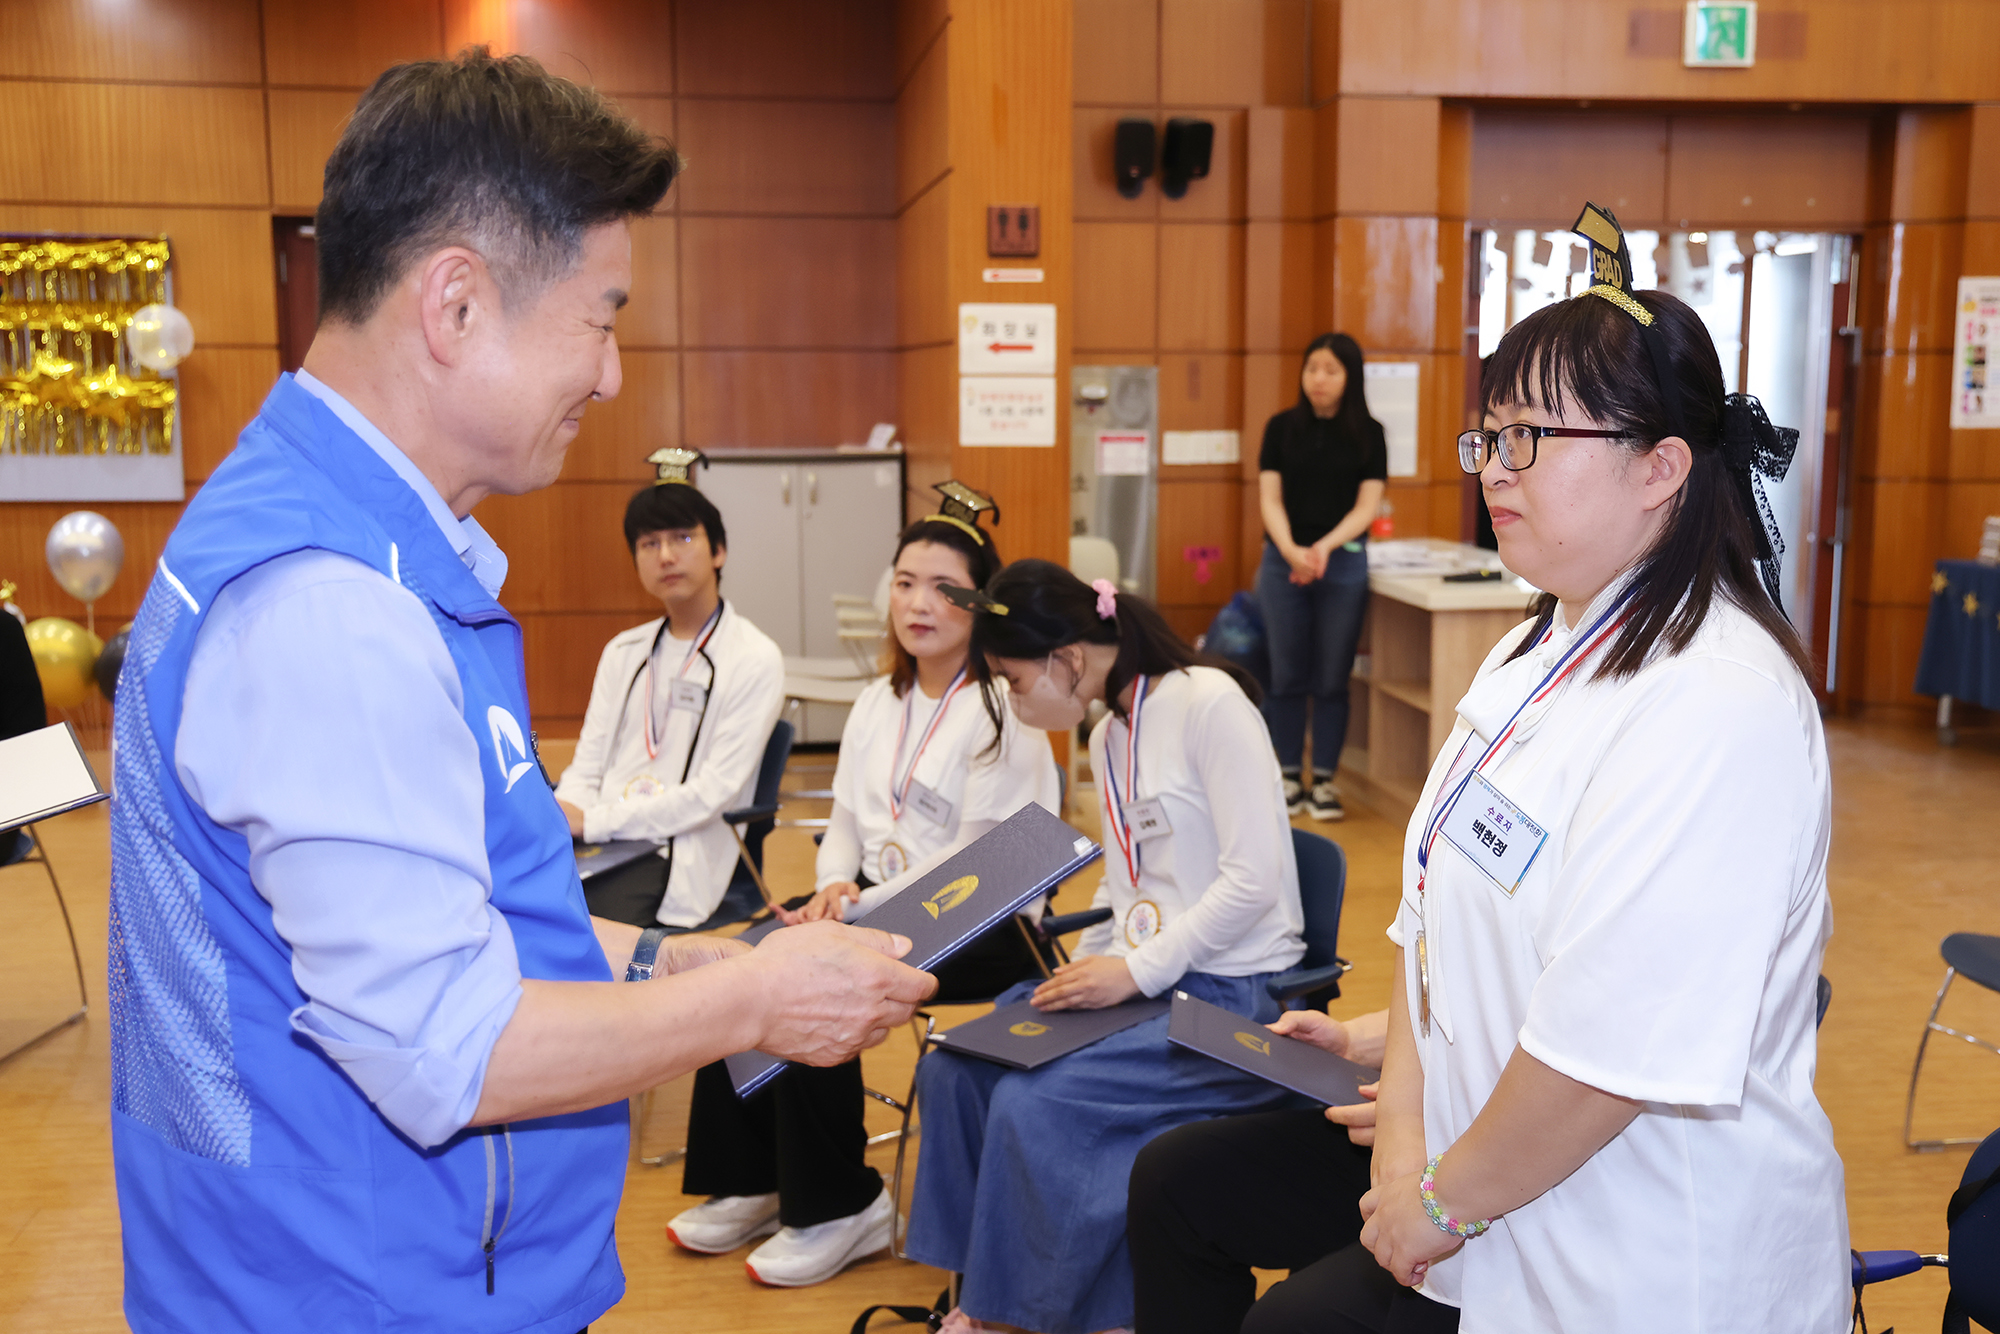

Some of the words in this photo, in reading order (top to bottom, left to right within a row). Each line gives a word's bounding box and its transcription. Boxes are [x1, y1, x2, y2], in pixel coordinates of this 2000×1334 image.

[1592, 247, 1622, 290] GRAD
[1487, 806, 1513, 832] 수료자
[1515, 812, 1542, 838] 도봉대전환
[1472, 819, 1508, 857] 백현정
